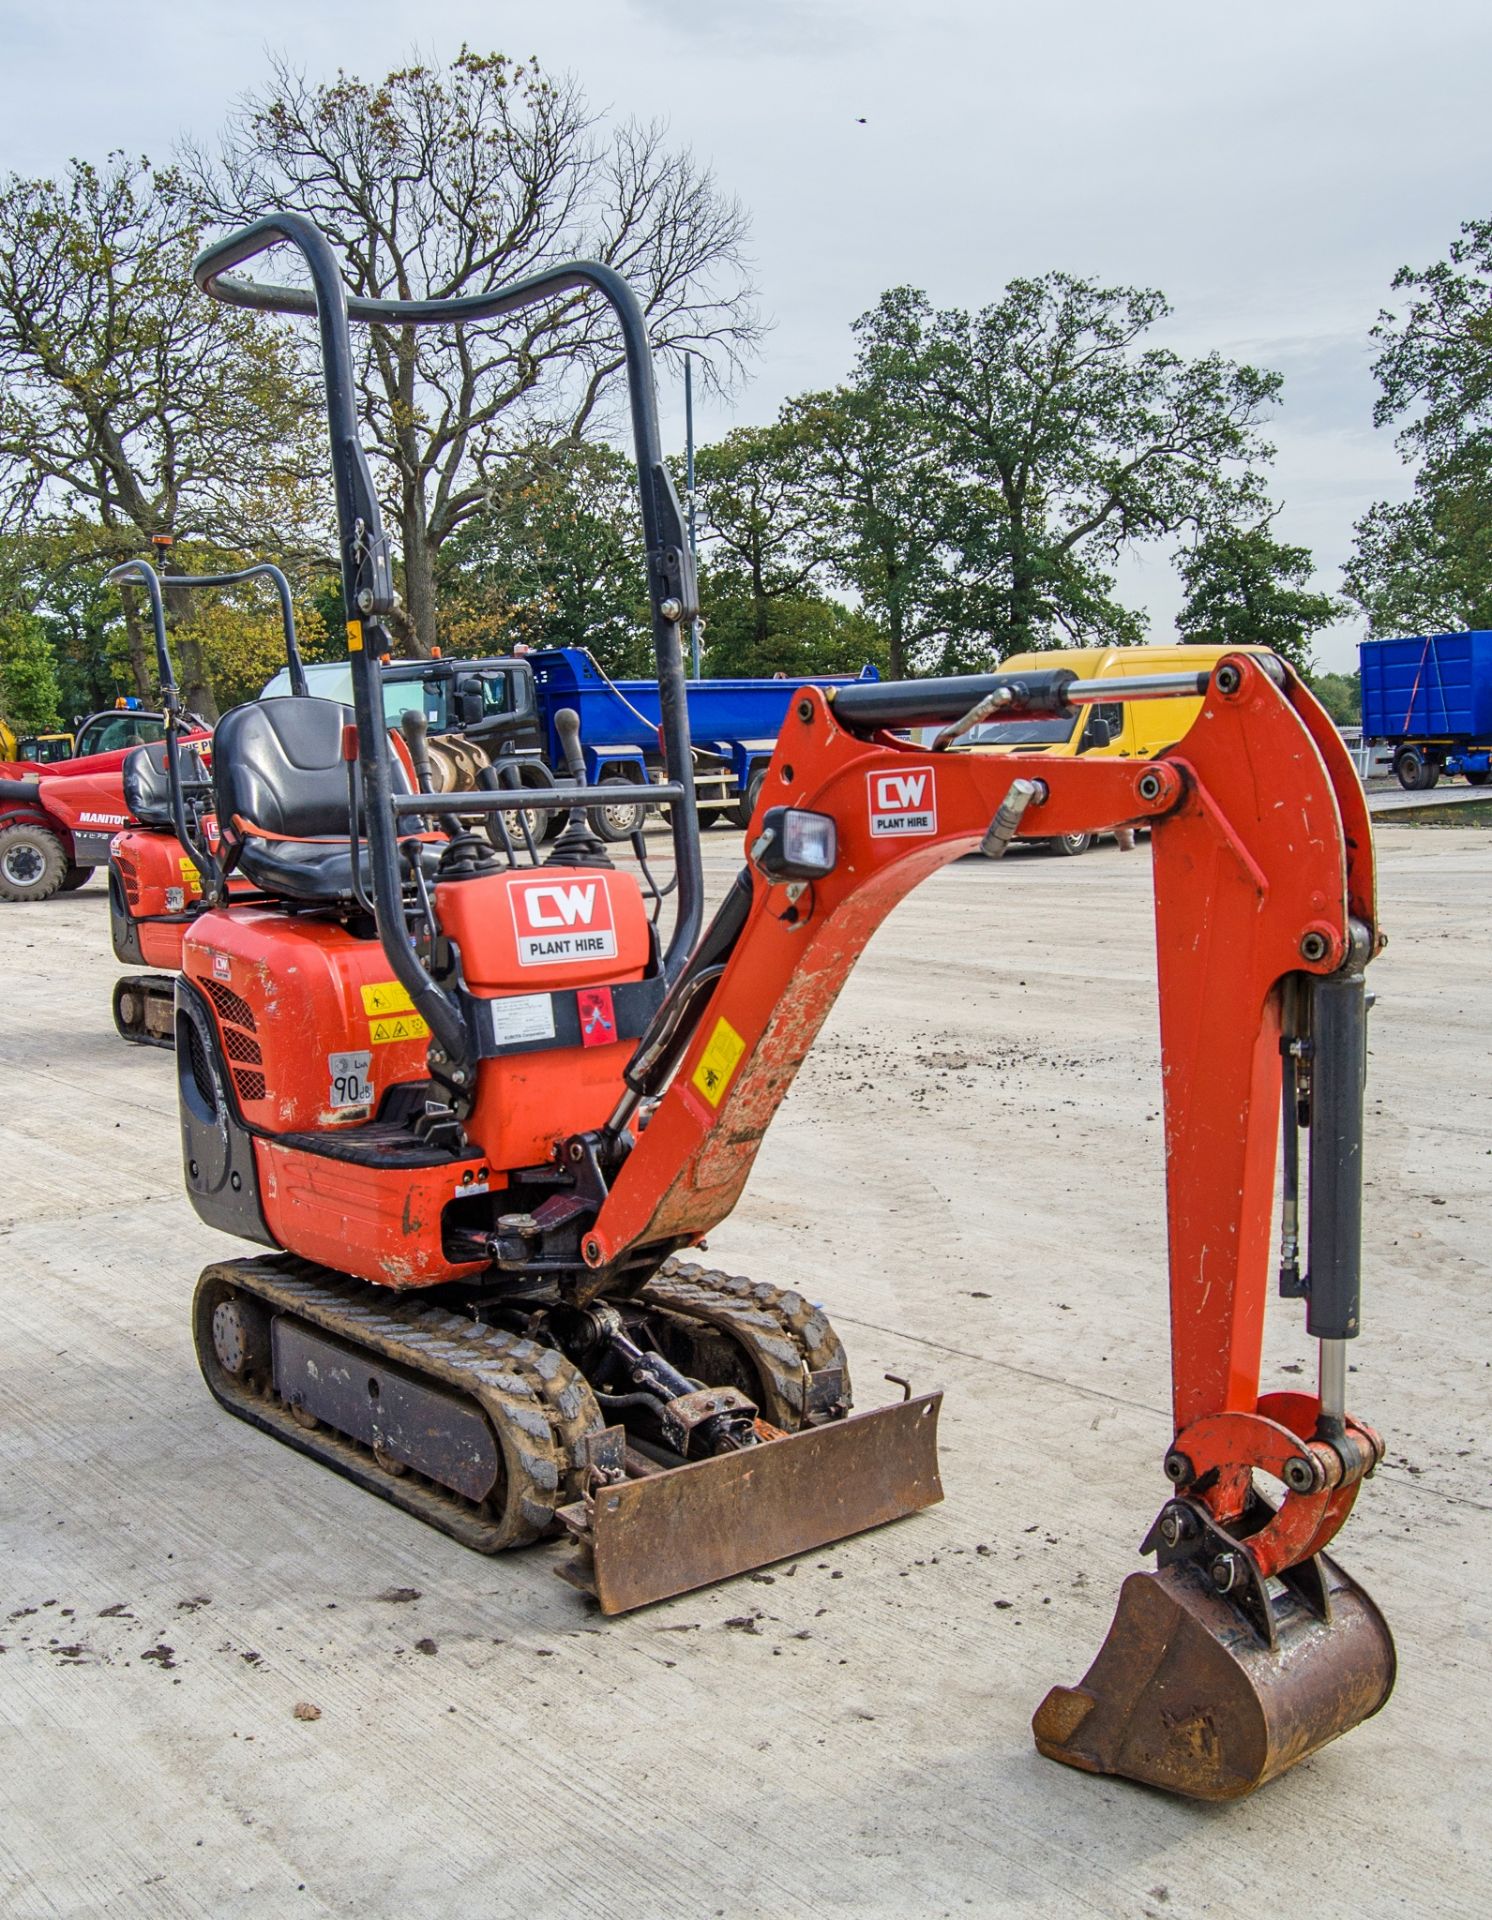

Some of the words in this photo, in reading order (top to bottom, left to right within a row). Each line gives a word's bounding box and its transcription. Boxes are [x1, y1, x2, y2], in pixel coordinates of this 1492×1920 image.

[877, 774, 927, 810] CW
[877, 817, 905, 830] PLANT
[907, 816, 928, 827] HIRE
[524, 884, 596, 928] CW
[530, 940, 570, 956] PLANT
[575, 938, 604, 952] HIRE
[334, 1075, 359, 1102] 90
